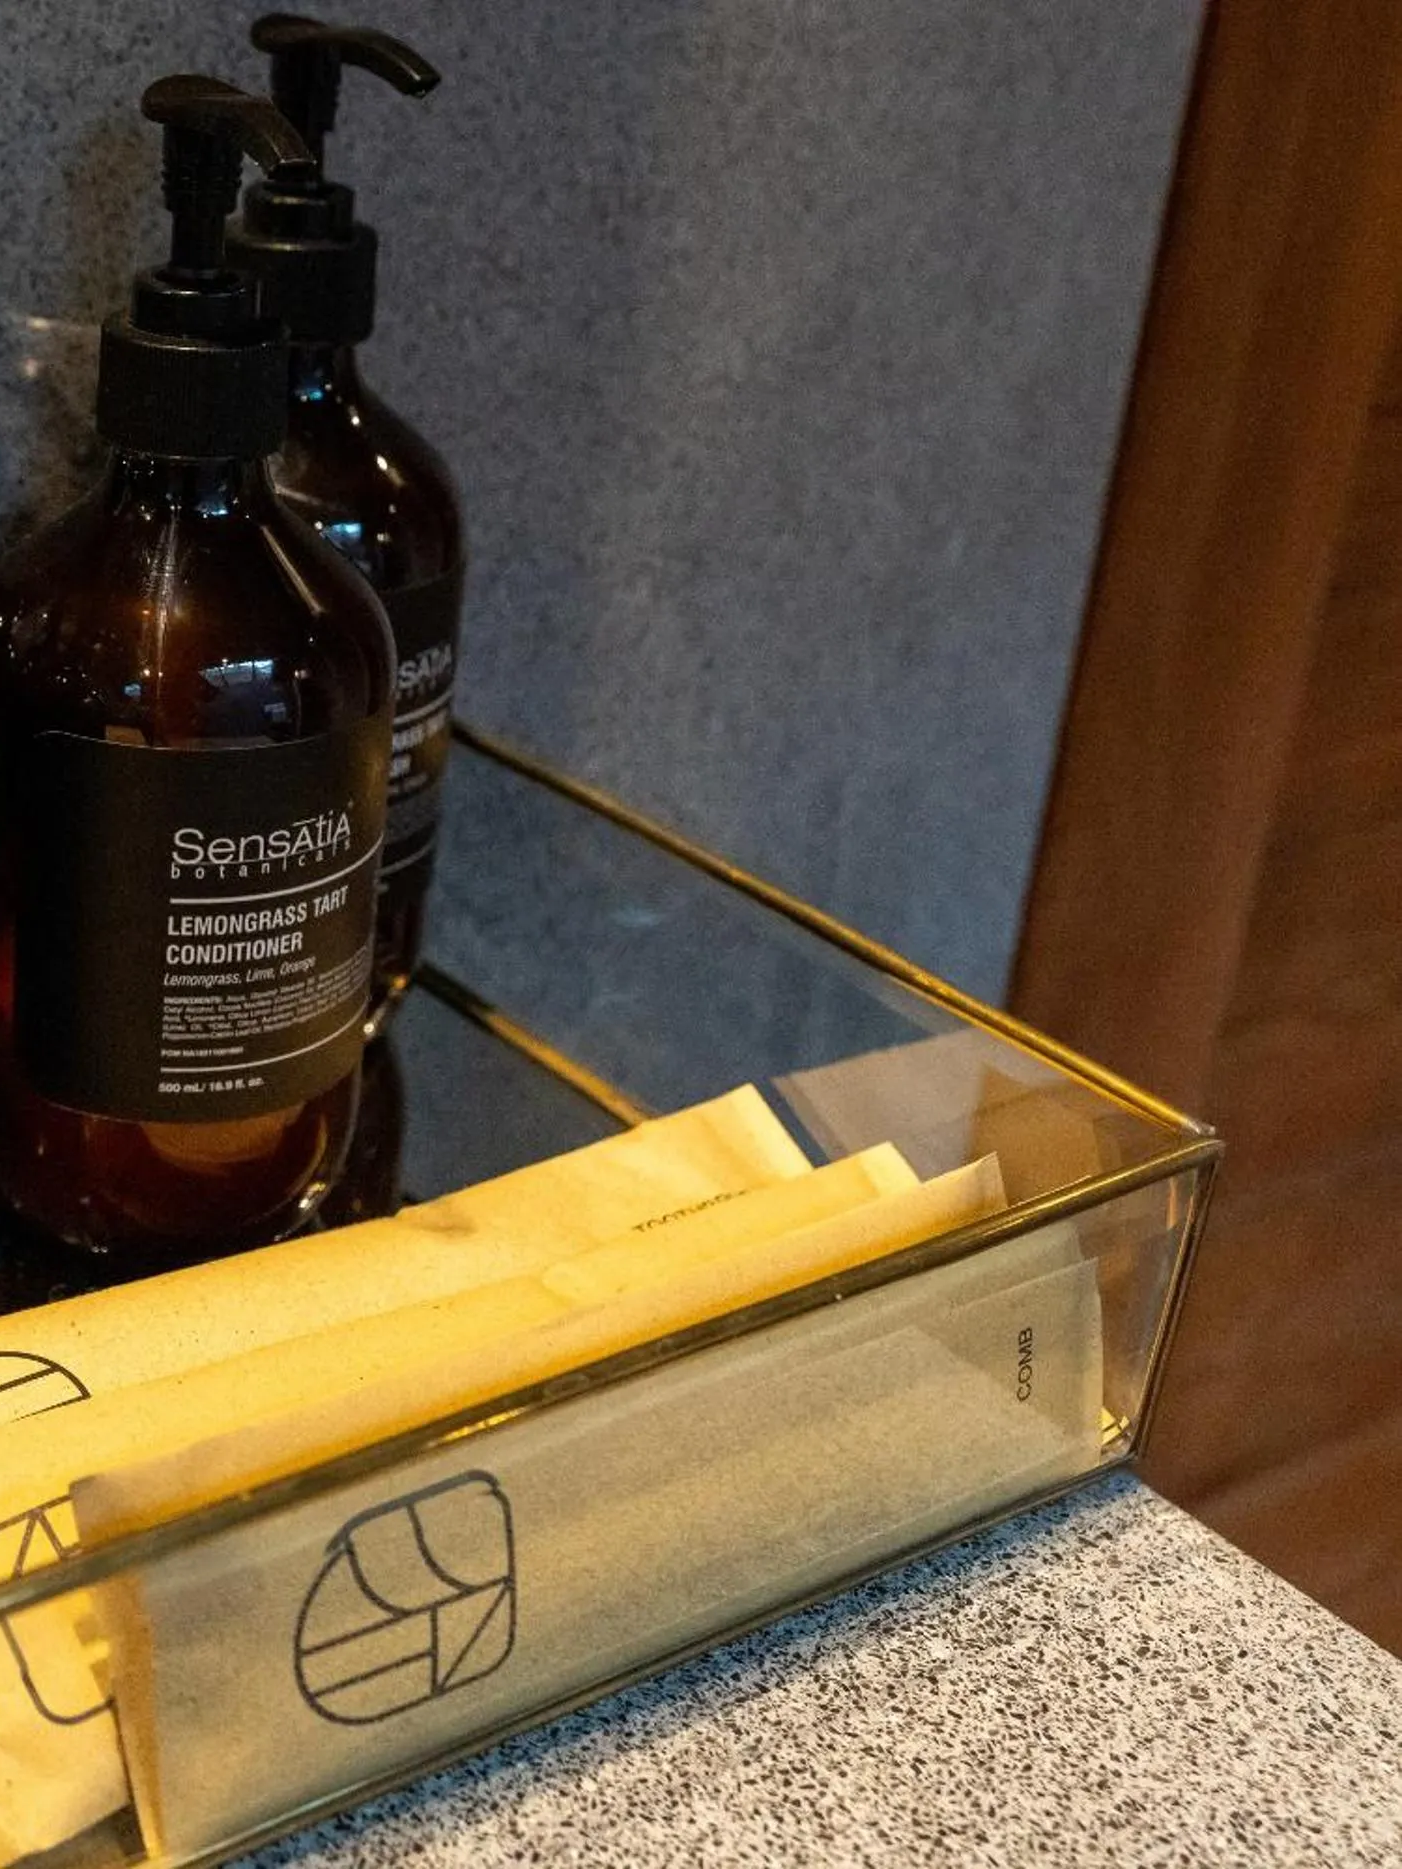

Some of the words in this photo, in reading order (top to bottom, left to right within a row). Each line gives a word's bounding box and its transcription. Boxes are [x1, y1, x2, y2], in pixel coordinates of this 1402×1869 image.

[170, 839, 351, 879] botanicals
[167, 901, 307, 936] LEMONGRASS
[313, 885, 348, 917] TART
[166, 931, 303, 965] CONDITIONER
[1016, 1327, 1033, 1402] COMB
